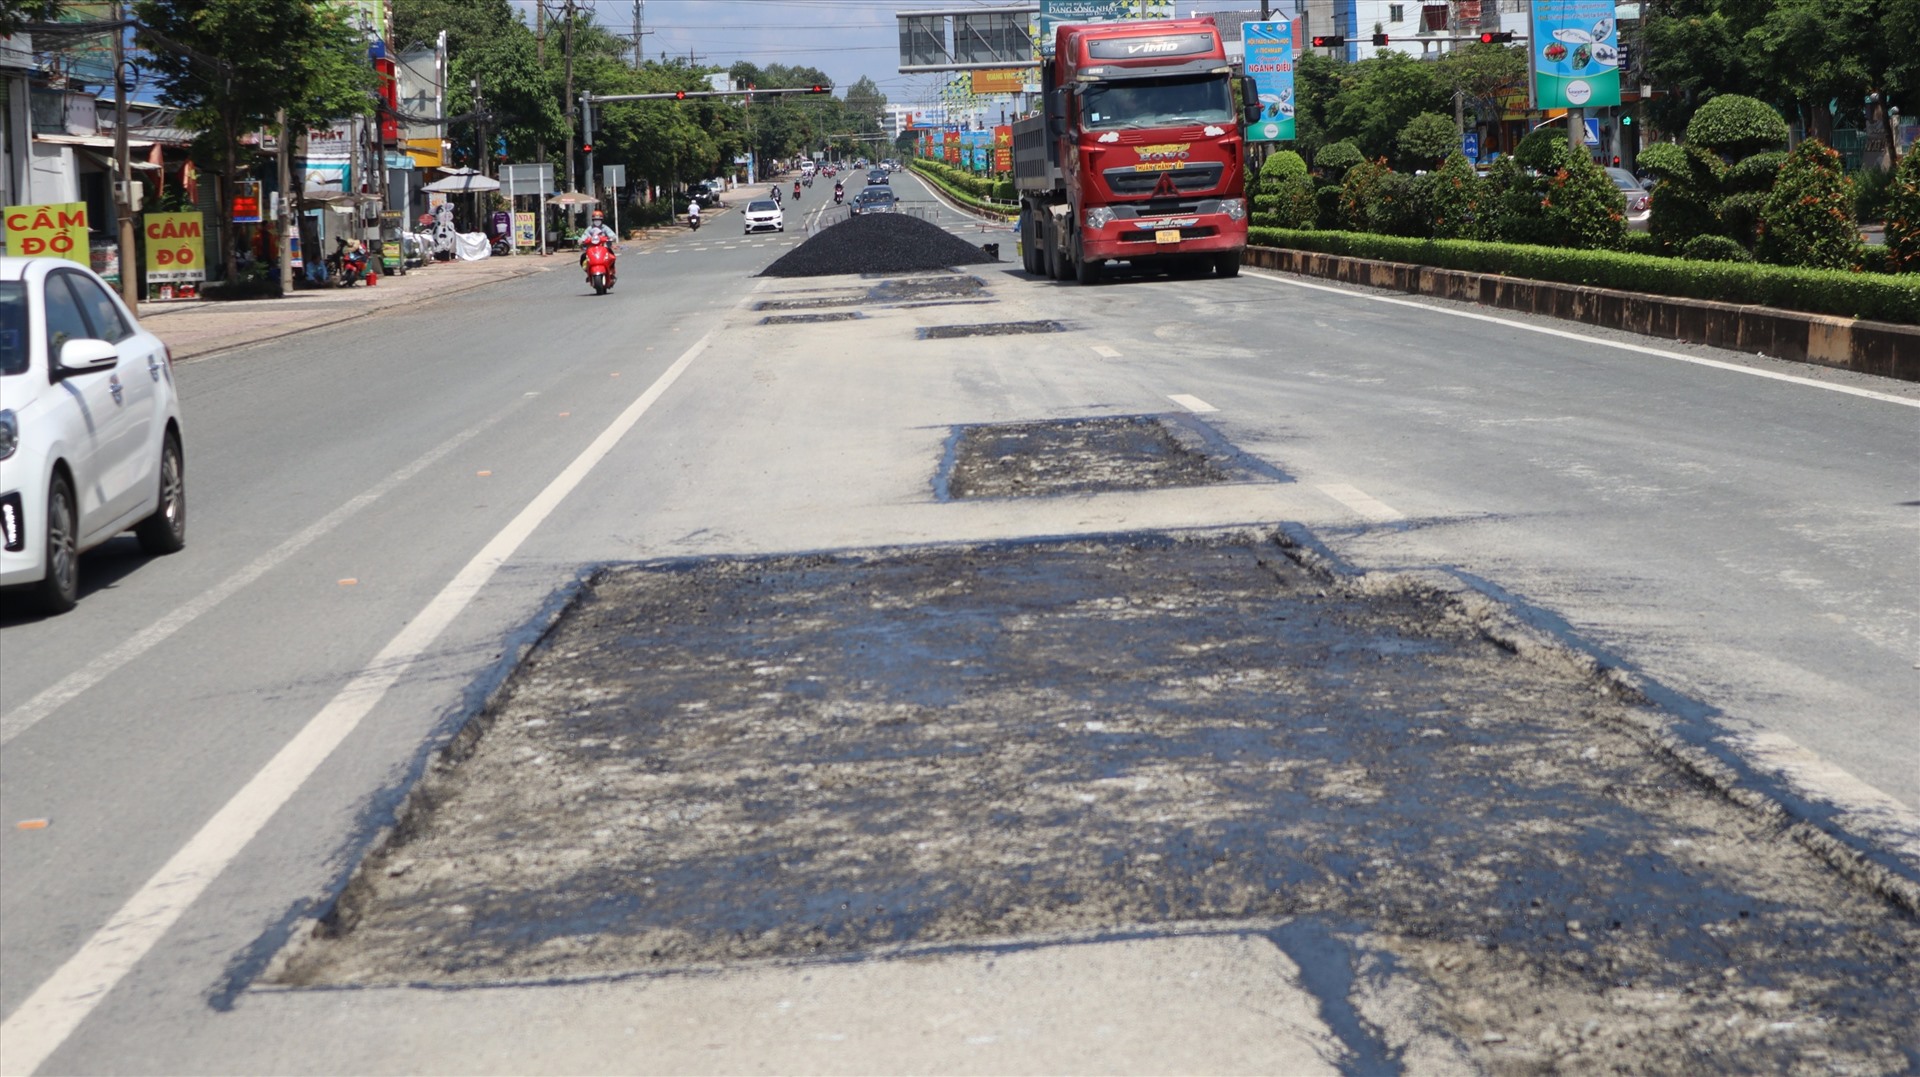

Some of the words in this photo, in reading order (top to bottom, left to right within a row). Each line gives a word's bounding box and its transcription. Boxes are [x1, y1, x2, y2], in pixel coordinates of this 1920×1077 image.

[1140, 152, 1190, 161] HOWO
[6, 206, 86, 232] CẦM
[147, 217, 200, 239] CẦM
[20, 229, 74, 255] ĐỒ
[156, 242, 194, 265] ĐỒ
